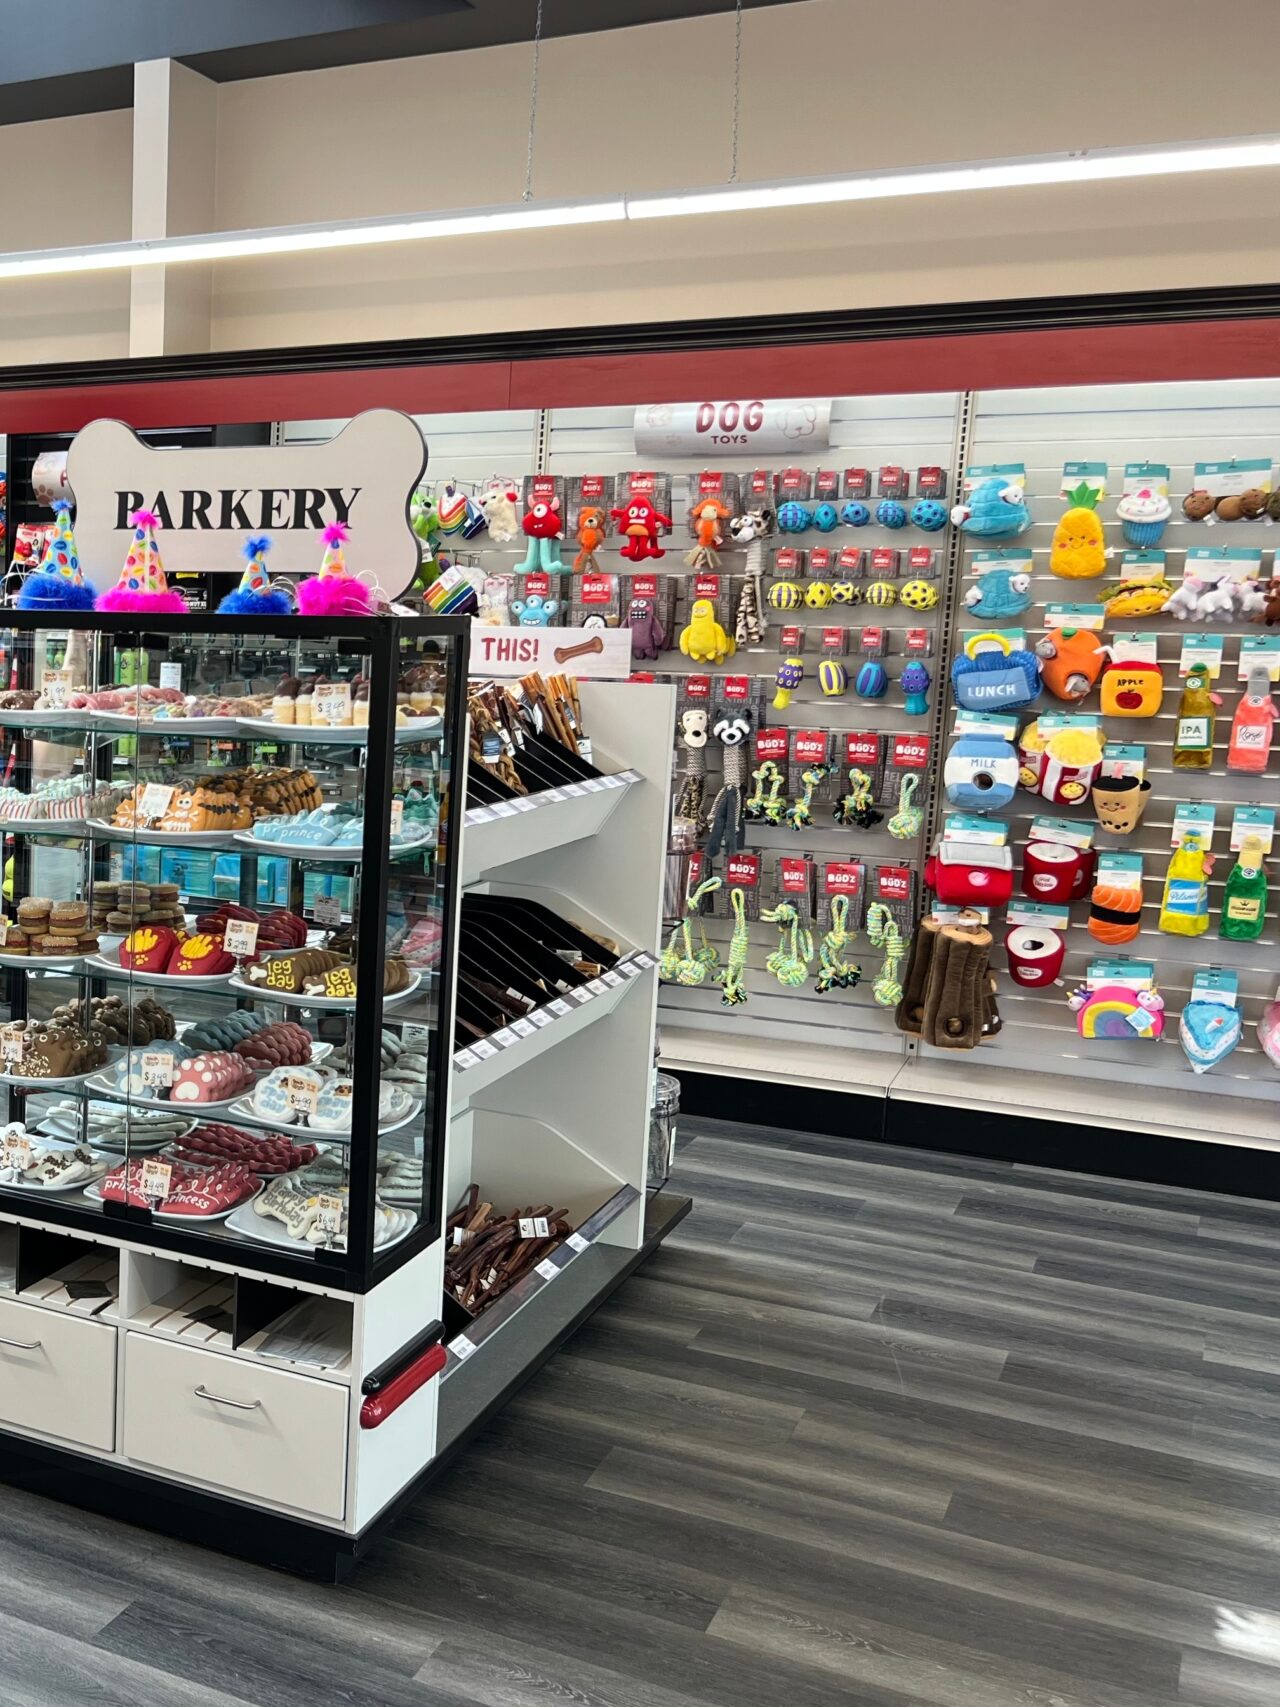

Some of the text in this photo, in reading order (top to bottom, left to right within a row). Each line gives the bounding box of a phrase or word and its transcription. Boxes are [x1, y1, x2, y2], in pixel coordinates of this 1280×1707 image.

[696, 401, 764, 433] DOG
[711, 435, 748, 444] TOYS
[112, 488, 362, 530] BARKERY
[481, 637, 539, 662] THIS!
[1117, 678, 1144, 687] APPLE
[968, 684, 1016, 698] LUNCH
[1181, 725, 1202, 735] IPA
[970, 758, 997, 769] MILK
[280, 829, 323, 841] prince
[267, 959, 293, 976] leg
[266, 974, 295, 990] day
[324, 967, 351, 986] leg
[325, 982, 357, 997] day
[161, 1193, 210, 1209] princess
[262, 1190, 305, 1228] Birthday
